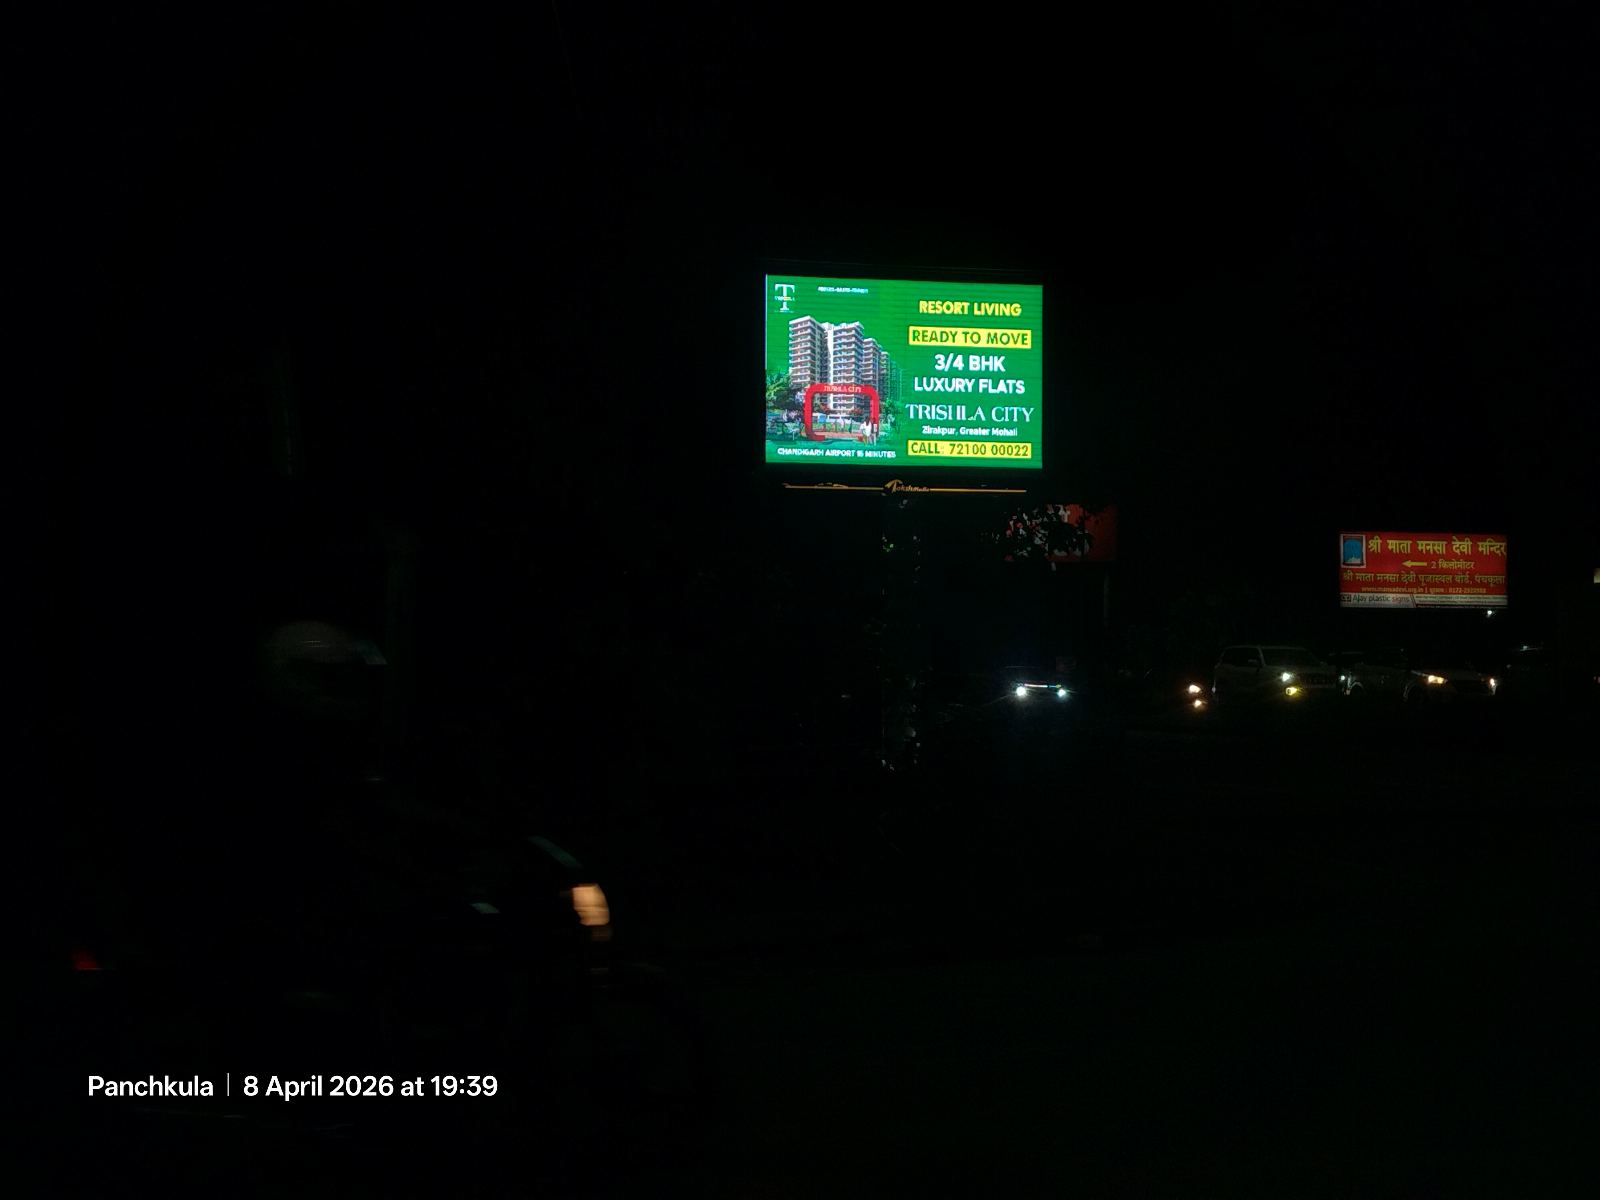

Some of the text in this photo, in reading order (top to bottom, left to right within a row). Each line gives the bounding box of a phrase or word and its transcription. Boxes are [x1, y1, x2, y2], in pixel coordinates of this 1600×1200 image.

[919, 300, 1022, 317] RESORT LIVING
[912, 329, 1029, 346] READY TO MOVE
[934, 353, 1006, 372] 3/4 BHK
[914, 377, 1026, 395] LUXURY FLATS
[991, 406, 1035, 422] CITY
[959, 426, 990, 436] Greater
[991, 427, 1018, 437] Mohali
[777, 447, 824, 457] CHANDIGARH
[825, 449, 856, 457] AIRPORT
[864, 450, 896, 459] MINUTES
[949, 443, 987, 455] 72100
[990, 444, 1029, 457] 00022
[1368, 536, 1382, 553] श्री
[1387, 538, 1412, 554] माता
[1417, 539, 1448, 555] मनसा
[1452, 536, 1472, 556] देवी
[1430, 559, 1475, 570] 2 किलोमीटर
[1343, 571, 1354, 582] श्री
[1355, 572, 1374, 582] माता
[1376, 573, 1399, 583] मनसा
[1401, 571, 1416, 584] देवी
[1368, 594, 1391, 603] plastic
